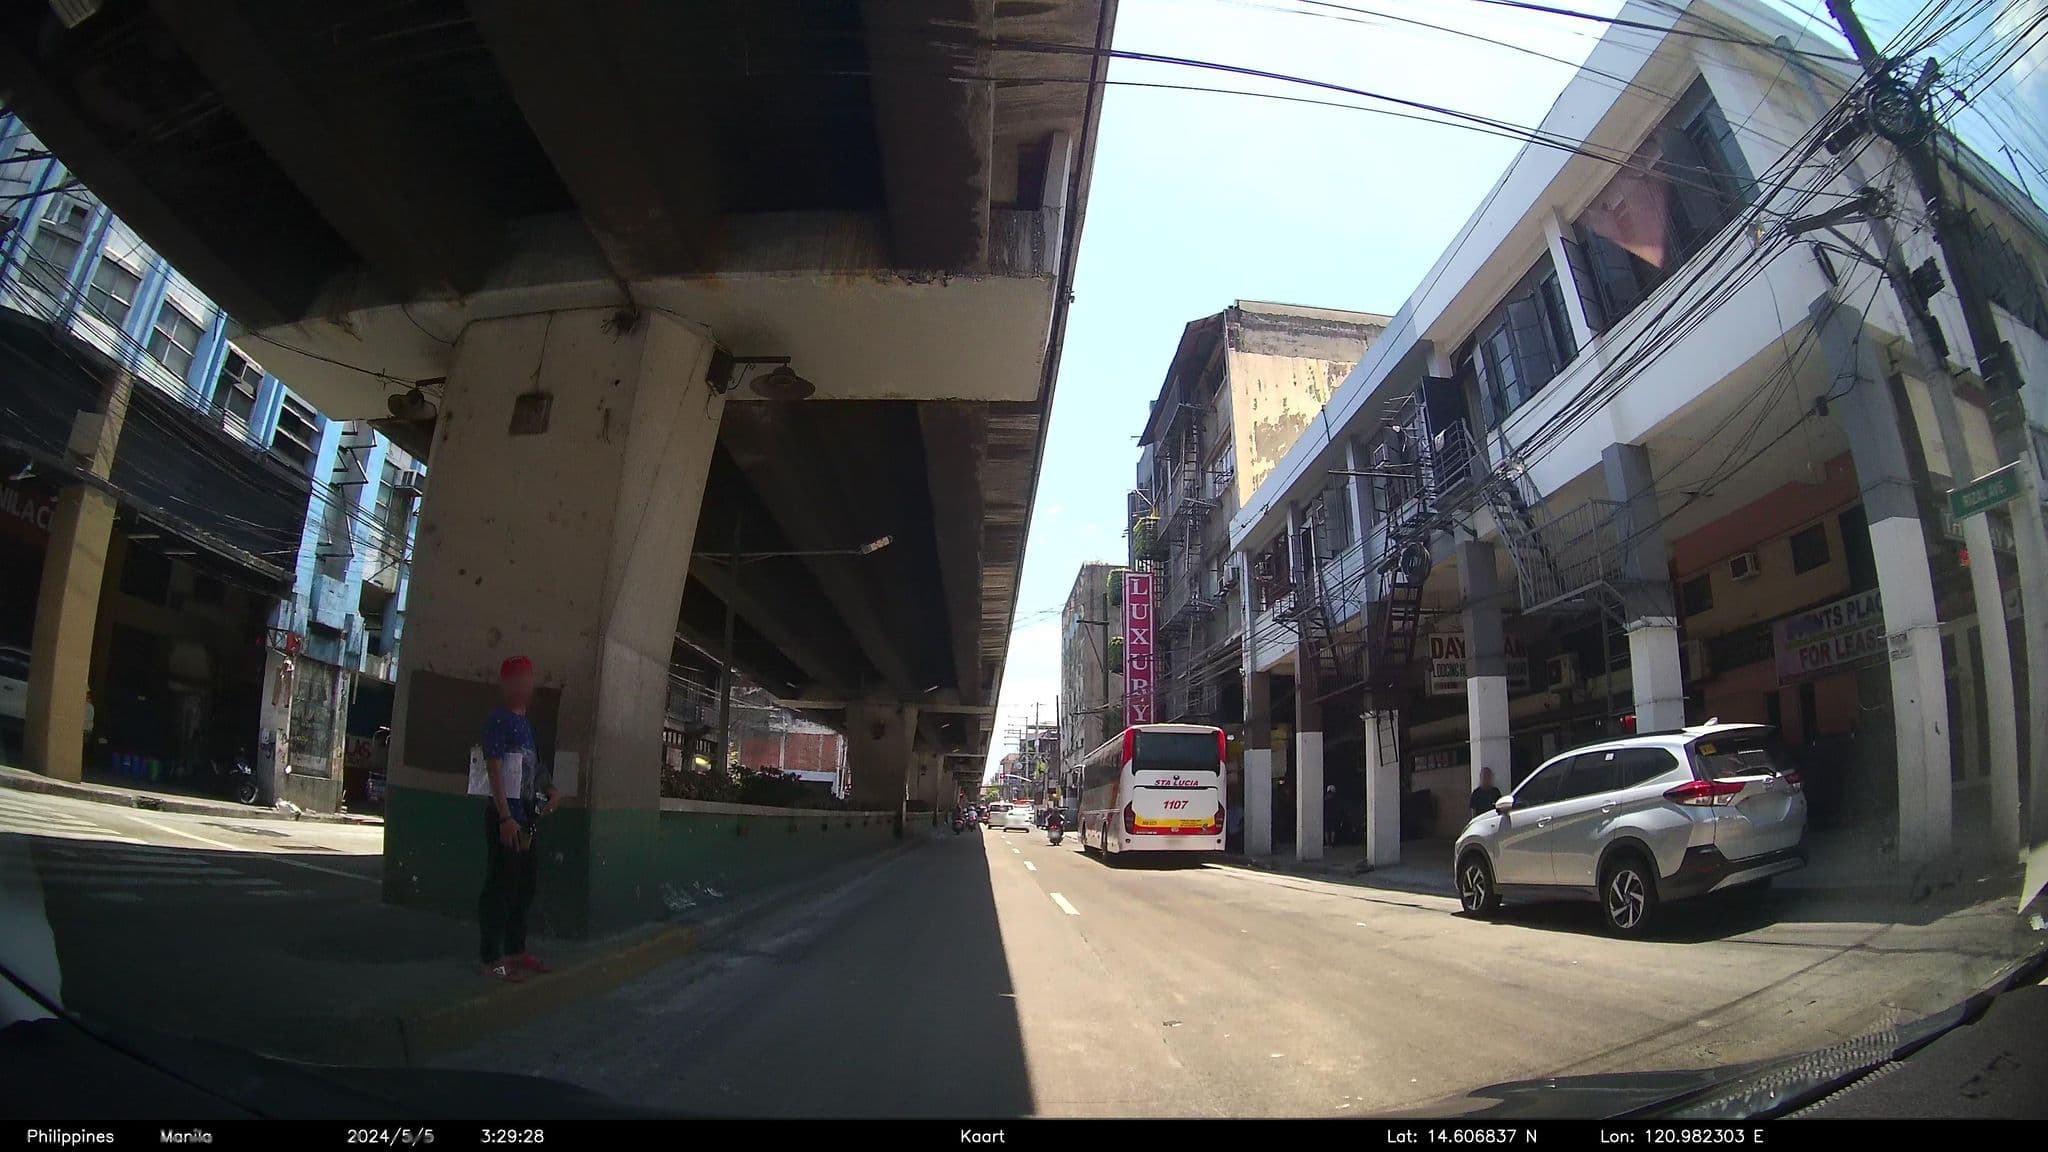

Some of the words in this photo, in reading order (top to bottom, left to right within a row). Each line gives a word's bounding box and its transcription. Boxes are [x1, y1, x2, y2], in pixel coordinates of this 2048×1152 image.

[1846, 591, 1883, 623] PLAC
[1130, 578, 1150, 722] LUXURY
[1799, 642, 1831, 669] FOR
[1163, 800, 1189, 810] 1107
